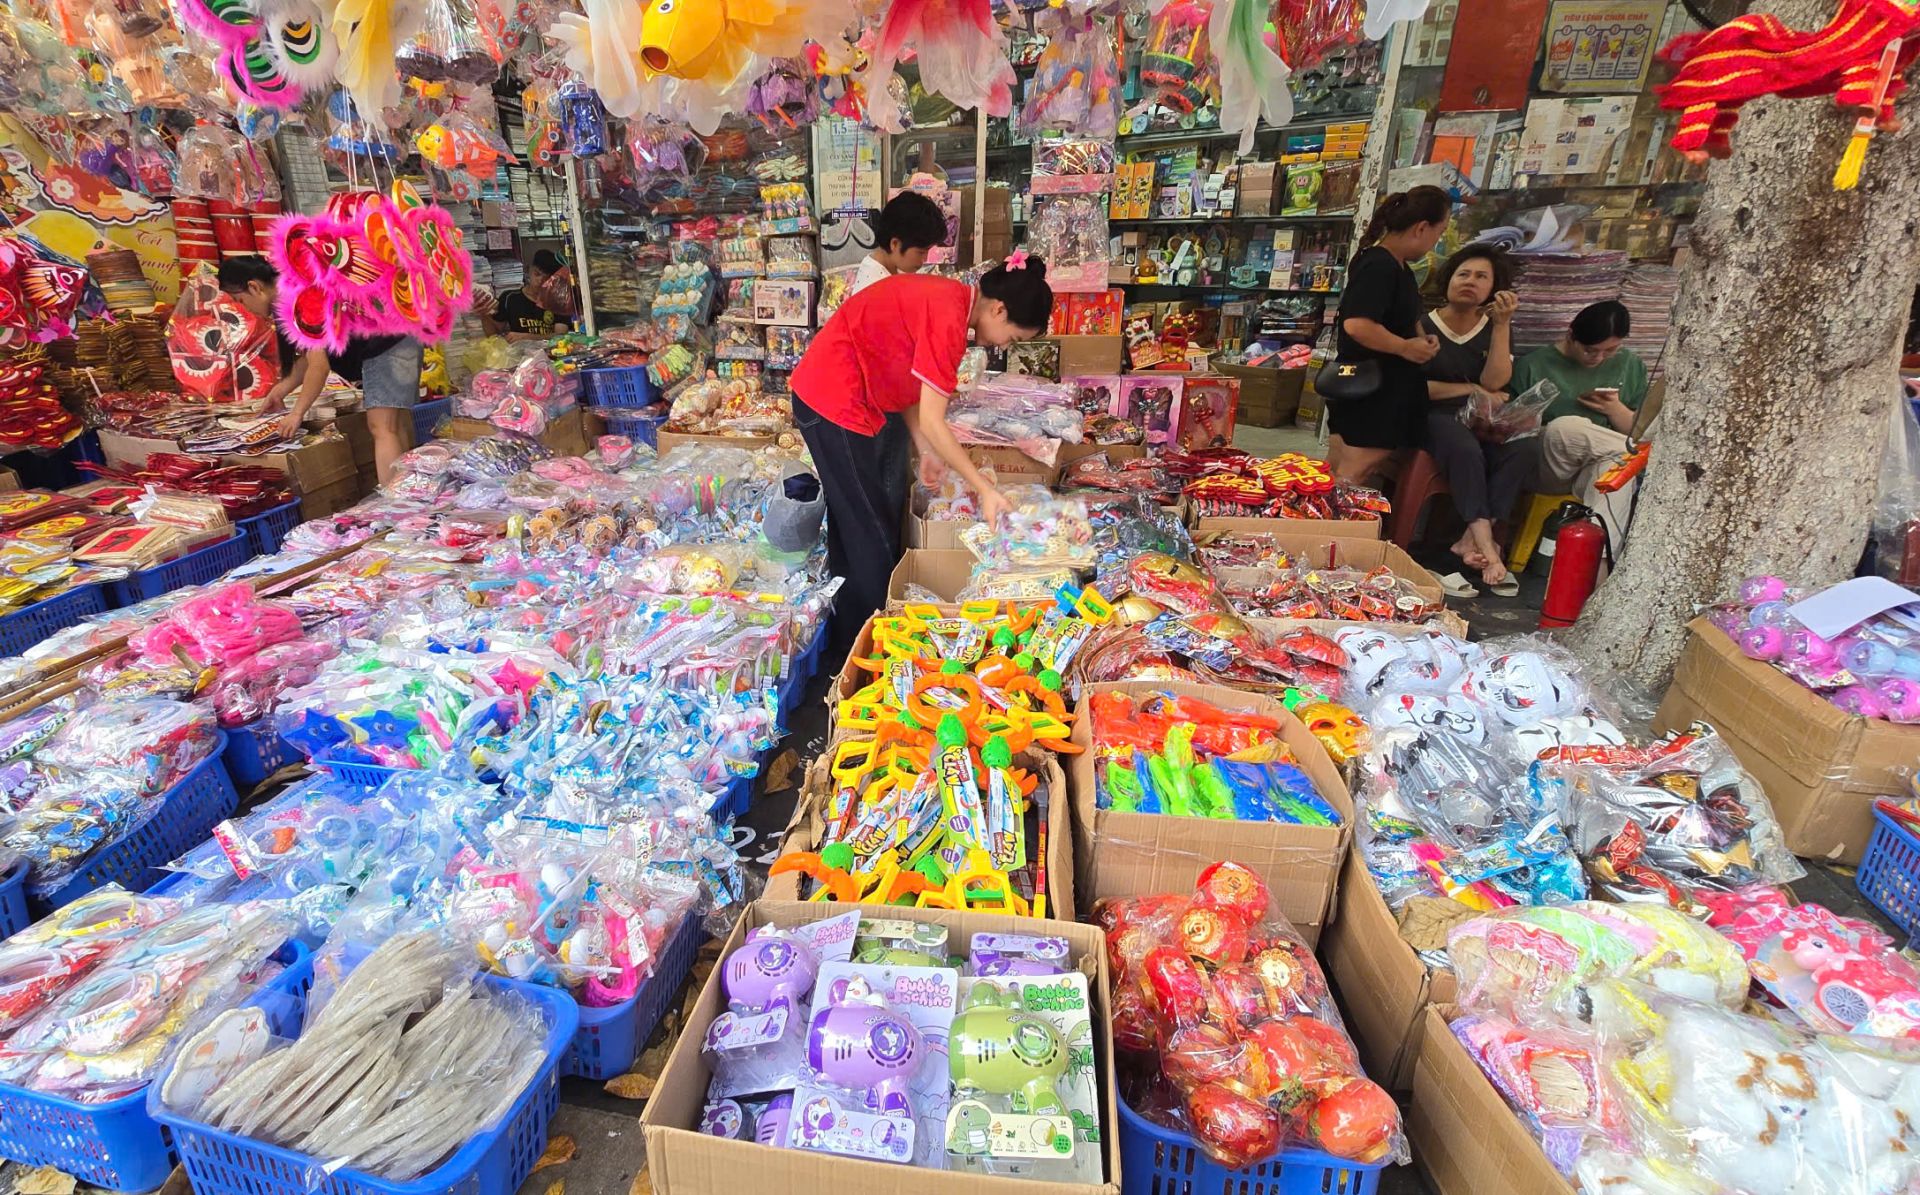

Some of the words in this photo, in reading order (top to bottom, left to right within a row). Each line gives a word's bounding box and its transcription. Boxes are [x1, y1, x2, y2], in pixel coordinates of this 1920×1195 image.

[942, 752, 963, 786] CLAW
[894, 975, 951, 996] Bubble
[1022, 983, 1081, 1001] Bubble
